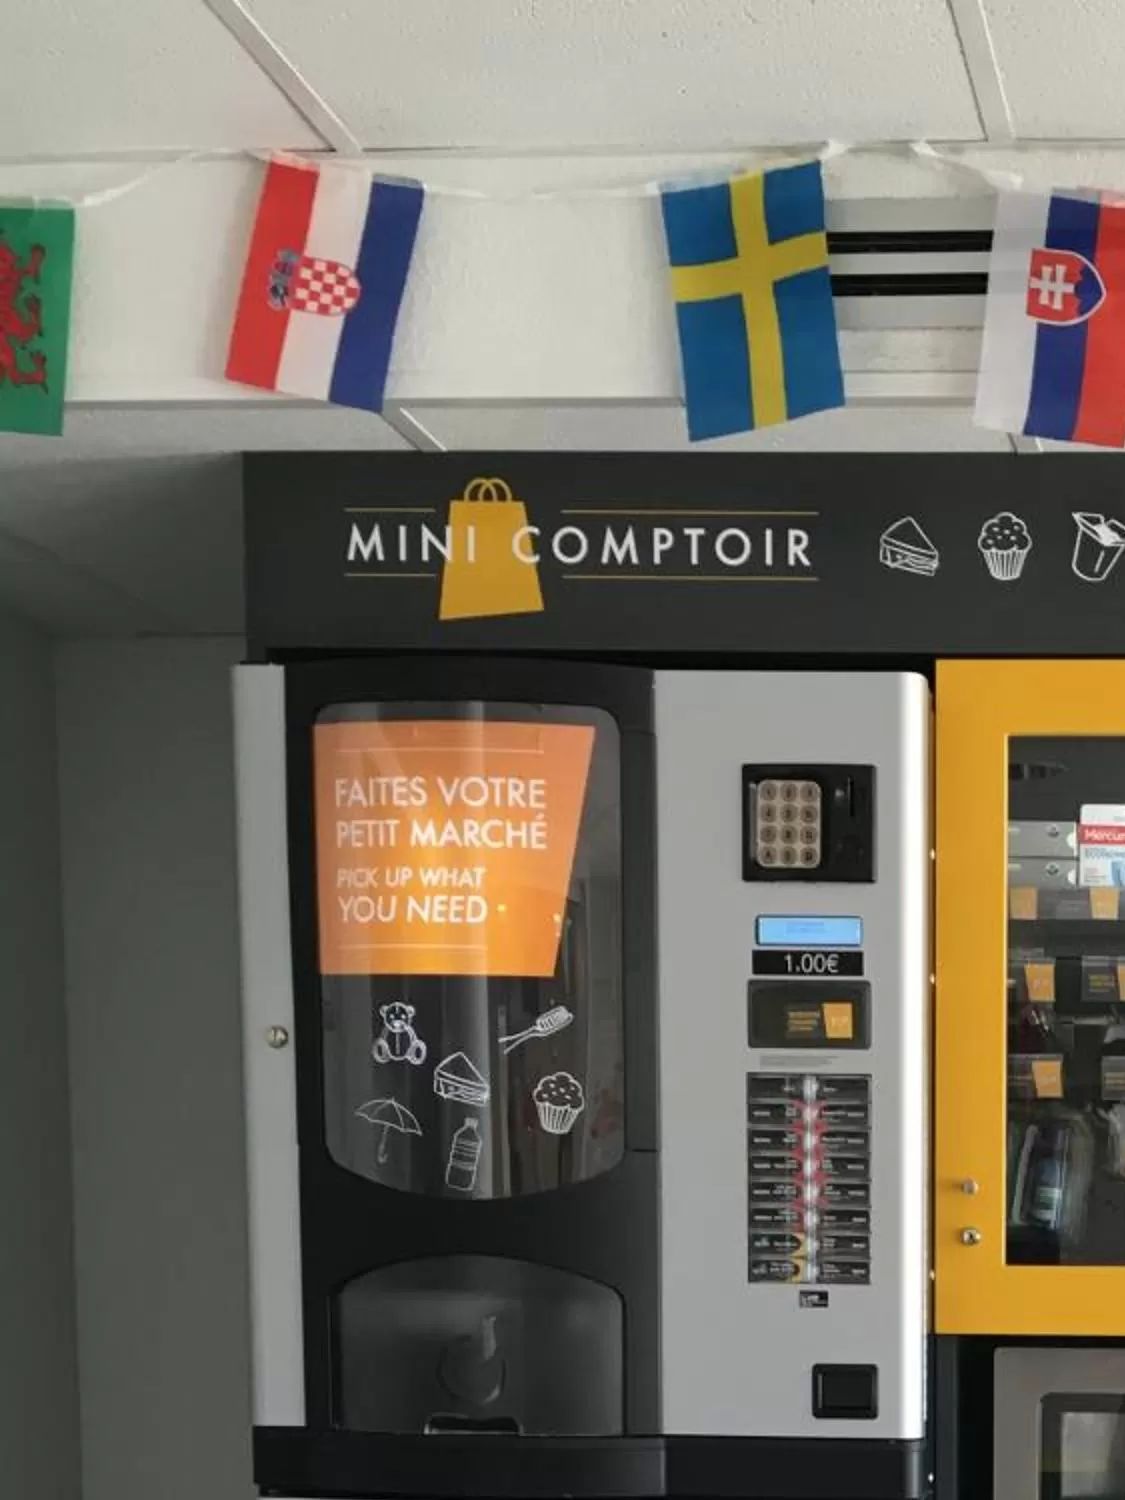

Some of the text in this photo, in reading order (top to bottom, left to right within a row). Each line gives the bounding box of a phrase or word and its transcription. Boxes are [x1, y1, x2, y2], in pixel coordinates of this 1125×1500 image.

[345, 524, 815, 568] MINI COMPTOIR
[335, 776, 547, 809] FAITES VOTRE
[335, 812, 548, 850] PETIT MARCHÉ
[336, 867, 488, 889] PICK UP WHAT
[338, 895, 488, 923] YOU NEED
[784, 953, 839, 973] 1.00€
